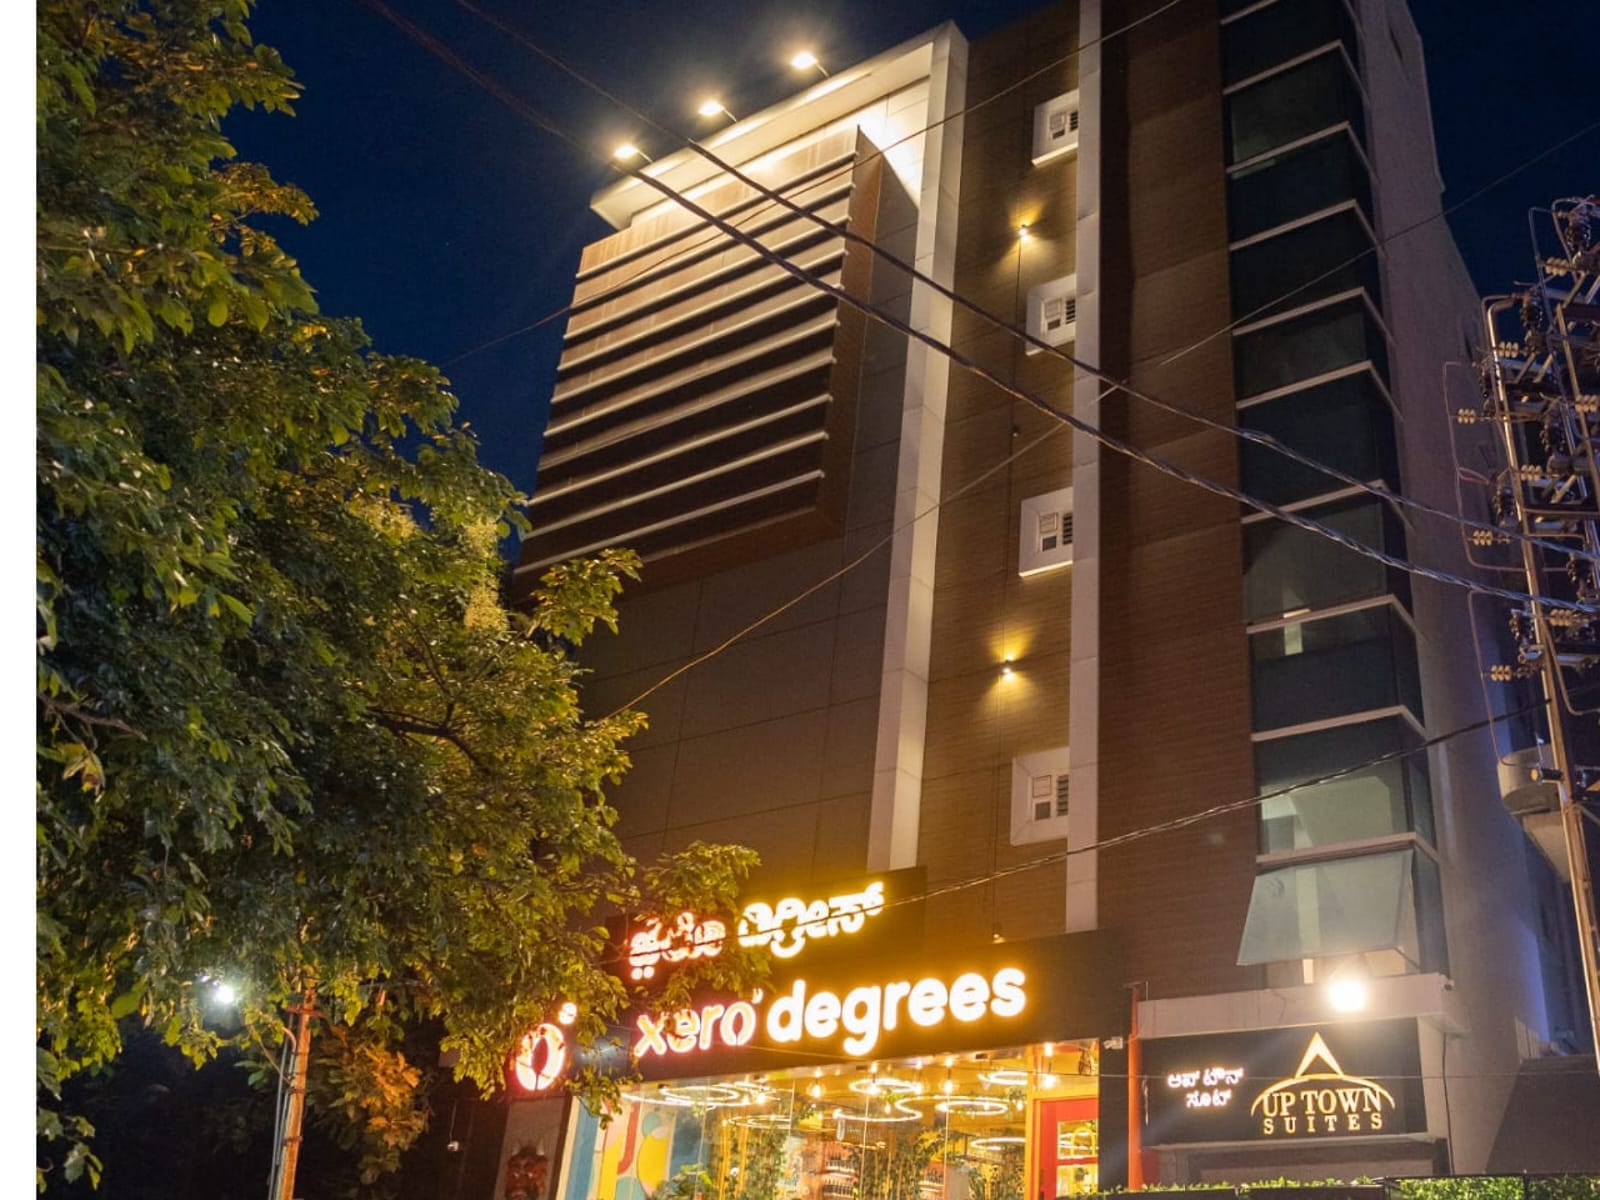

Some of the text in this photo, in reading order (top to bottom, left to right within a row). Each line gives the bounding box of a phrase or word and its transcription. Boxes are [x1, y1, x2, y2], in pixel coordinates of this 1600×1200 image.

[766, 968, 1026, 1056] degrees
[1262, 1088, 1382, 1117] UP TOWN
[1263, 1112, 1383, 1135] SUITES
